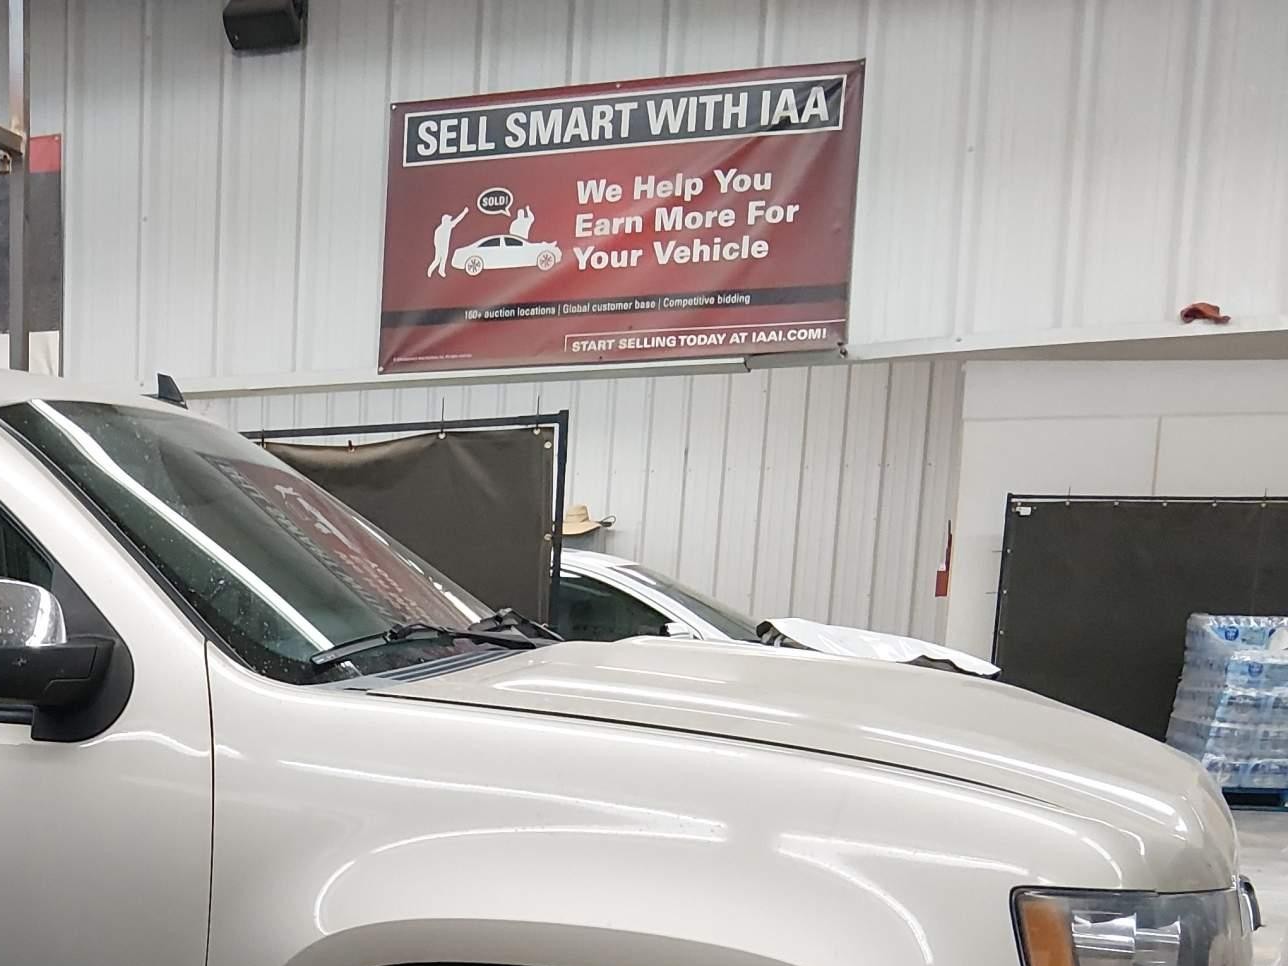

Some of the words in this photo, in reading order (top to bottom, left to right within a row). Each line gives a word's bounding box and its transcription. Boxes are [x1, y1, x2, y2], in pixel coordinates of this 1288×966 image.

[416, 115, 496, 157] SELL
[504, 101, 638, 148] SMART
[646, 91, 748, 136] WITH
[760, 86, 829, 127] IAA
[481, 195, 509, 207] SOLD!
[576, 178, 623, 205] We
[633, 173, 704, 202] Help
[714, 168, 773, 194] You
[575, 213, 644, 238] Earn
[654, 206, 736, 232] More
[747, 200, 800, 225] For
[573, 246, 644, 271] Your
[653, 235, 769, 265] Vehicle
[484, 306, 516, 320] auction
[517, 303, 556, 317] locations
[562, 301, 591, 314] Global
[592, 299, 633, 313] customer
[634, 298, 656, 310] base
[663, 295, 715, 308] Competitive
[717, 291, 751, 305] bidding
[572, 338, 615, 353] START
[618, 334, 677, 350] SELLING
[678, 331, 728, 348] TODAY
[729, 331, 748, 345] AT
[751, 327, 828, 344] IAAI.COM!
